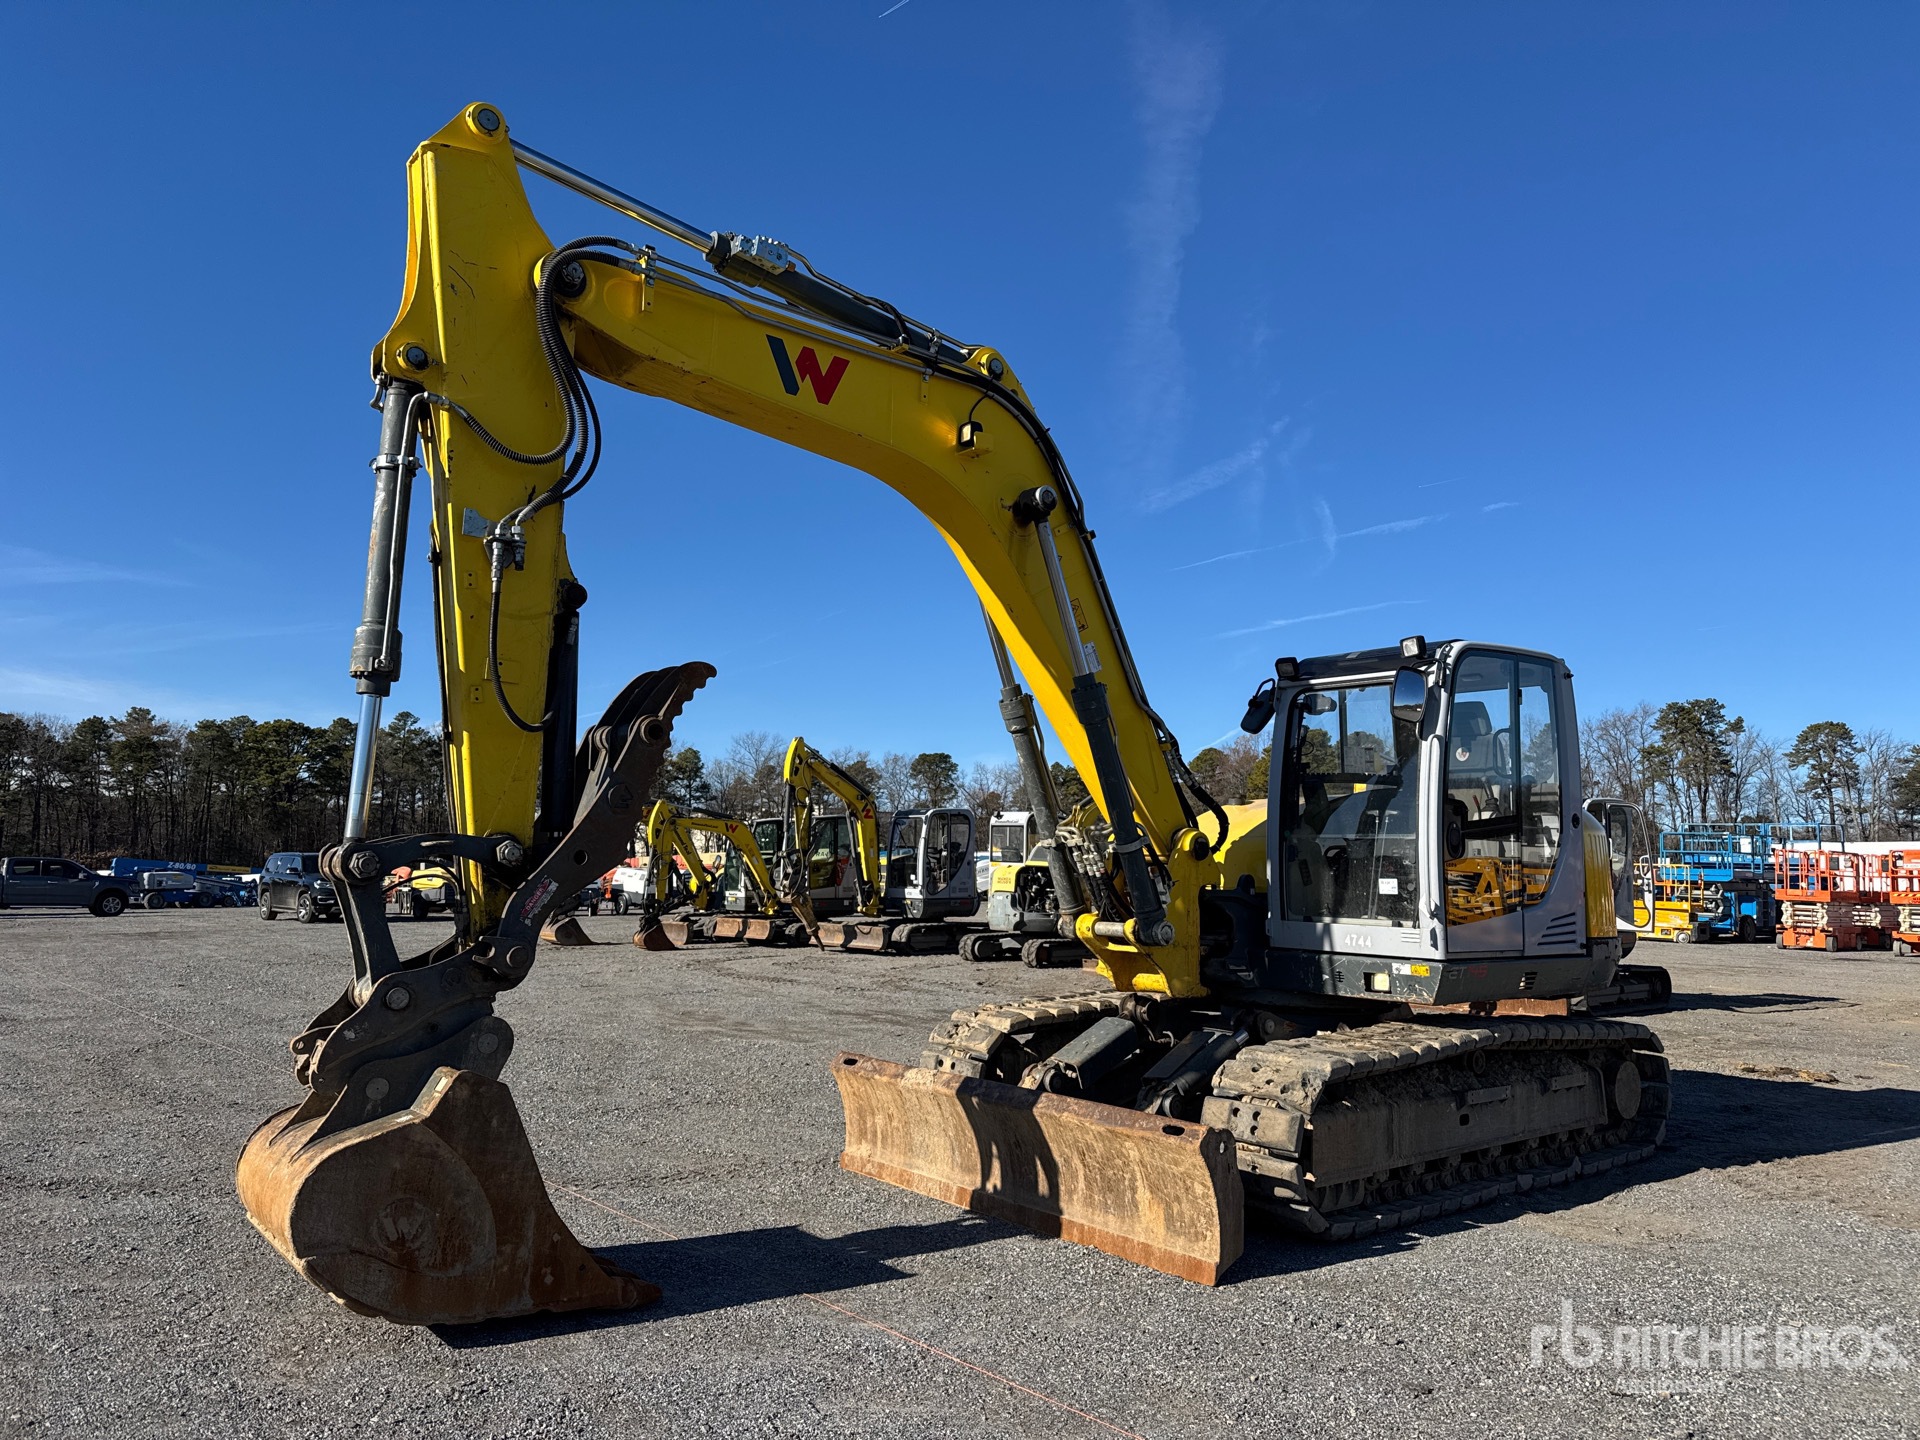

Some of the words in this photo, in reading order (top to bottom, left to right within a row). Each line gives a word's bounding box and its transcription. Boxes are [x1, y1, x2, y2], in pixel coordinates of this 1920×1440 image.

[167, 861, 196, 871] Z-80/60
[525, 887, 545, 911] DANGER
[1344, 934, 1372, 948] 4744
